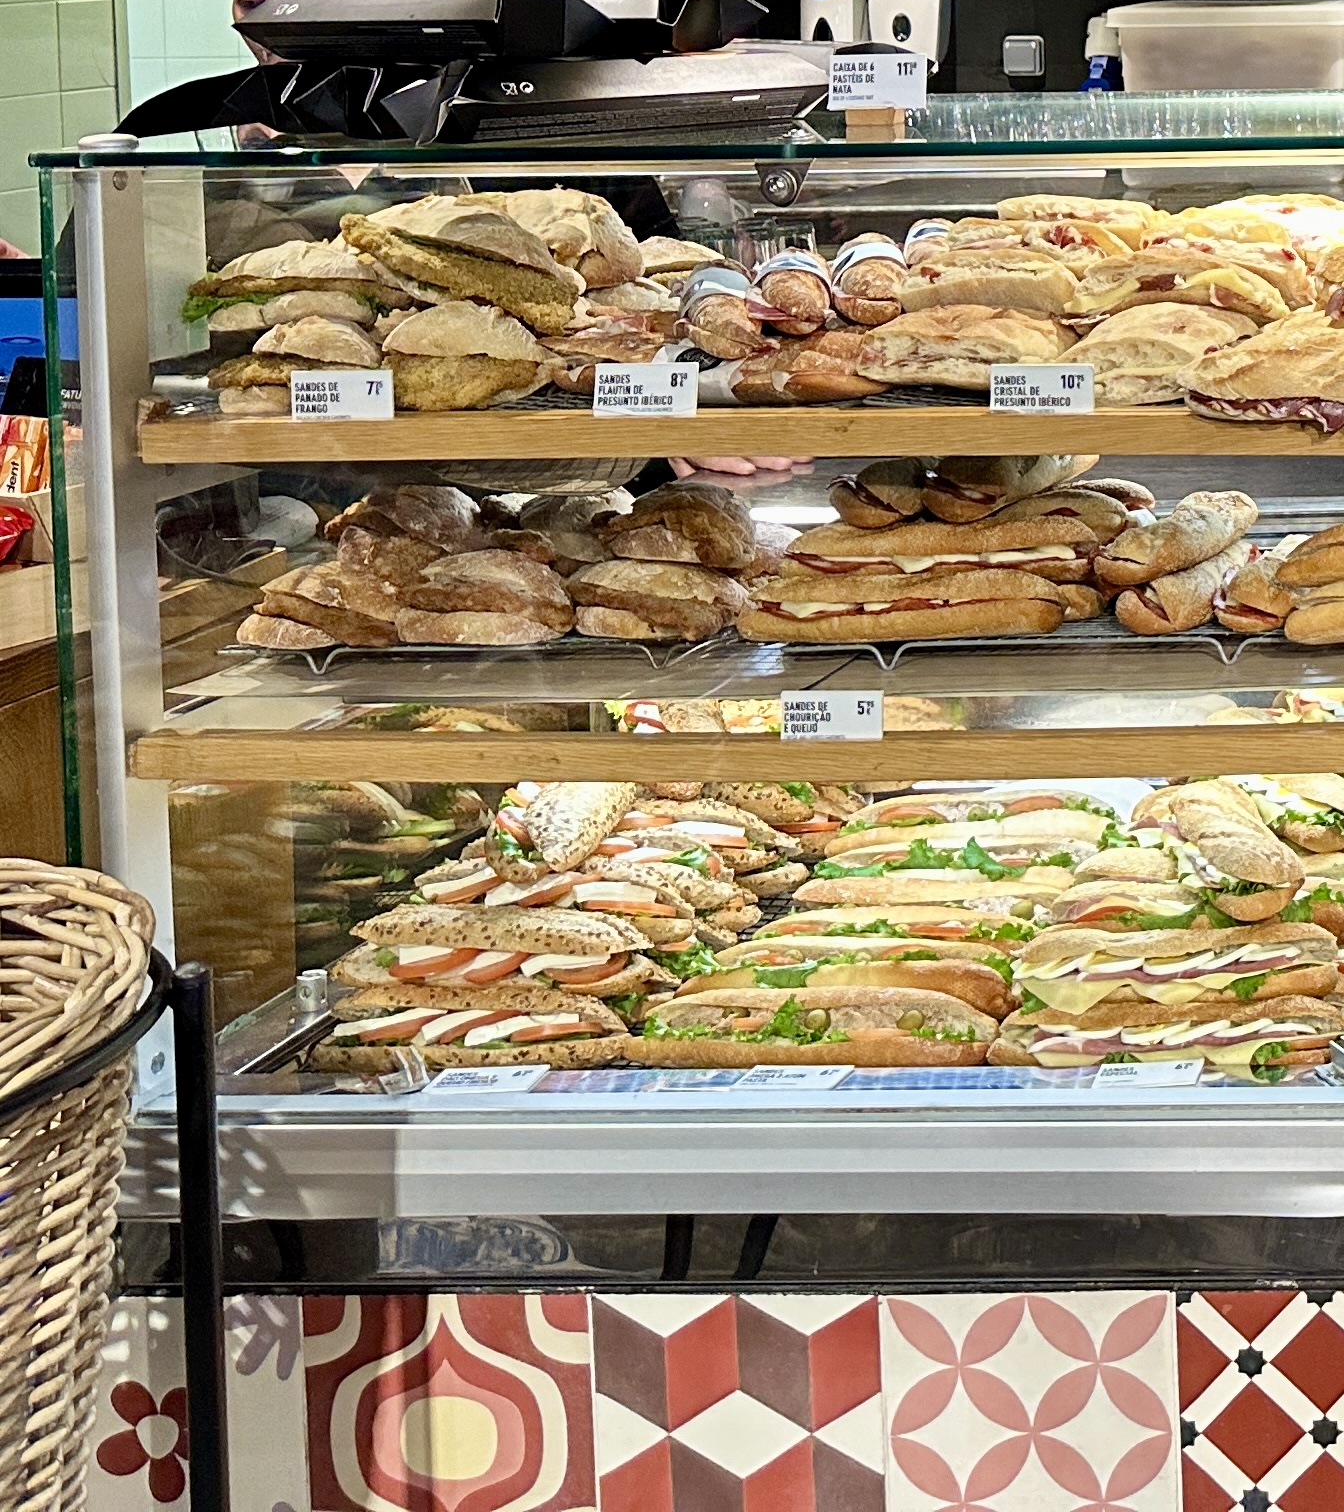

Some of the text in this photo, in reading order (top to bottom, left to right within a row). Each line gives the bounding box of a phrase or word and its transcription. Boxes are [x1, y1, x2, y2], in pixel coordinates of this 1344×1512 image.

[833, 62, 875, 73] CAIXA DE 6
[865, 73, 875, 83] DE
[832, 84, 853, 94] NATA
[598, 373, 631, 384] SANDES
[993, 375, 1026, 385] SANDES
[294, 381, 339, 392] SANDES DE
[633, 384, 644, 394] DE
[993, 386, 1041, 396] CRISTAL DE
[295, 392, 340, 403] PANADO DE
[597, 392, 673, 406] PRESUNTO IBÉRICO
[993, 393, 1071, 407] PRESUNTO IBÉRICO
[295, 403, 328, 414] FRANGO
[783, 700, 828, 712] SANDES DE
[783, 722, 818, 734] E QUEIJO
